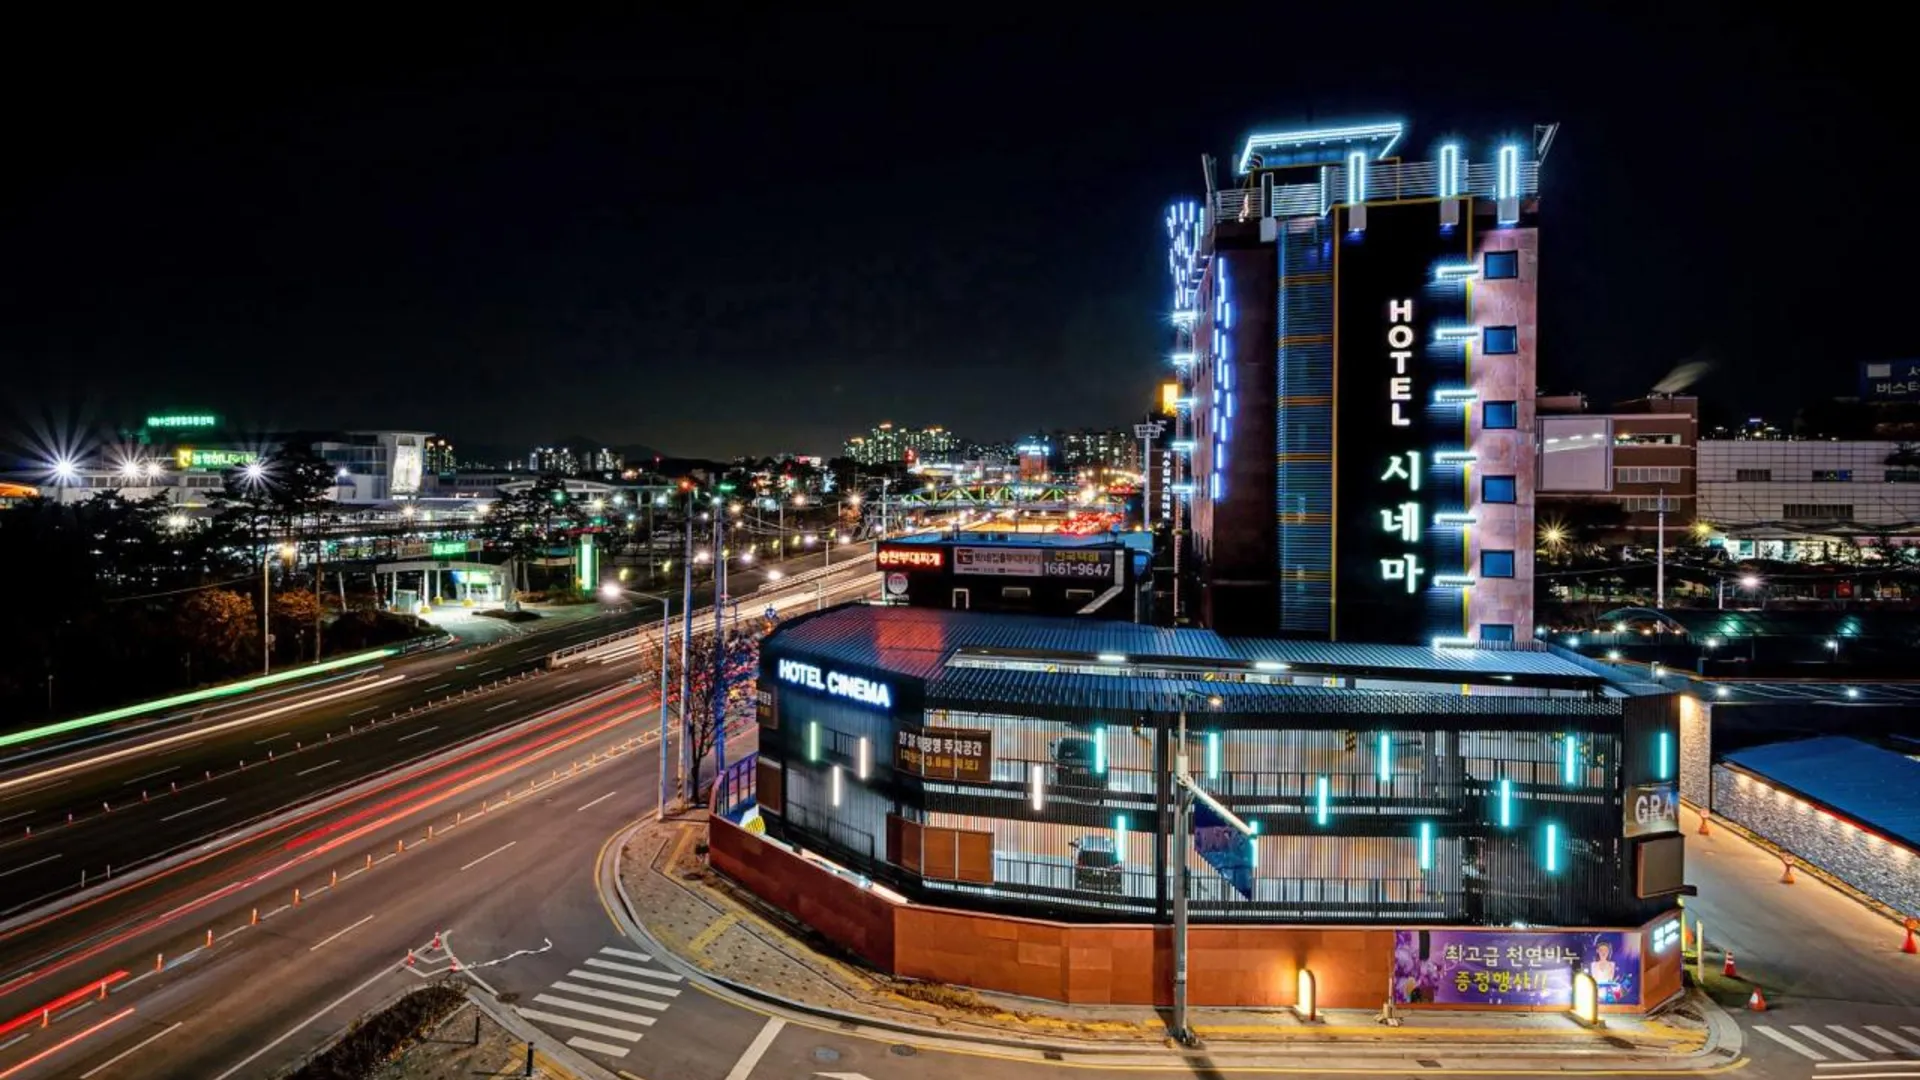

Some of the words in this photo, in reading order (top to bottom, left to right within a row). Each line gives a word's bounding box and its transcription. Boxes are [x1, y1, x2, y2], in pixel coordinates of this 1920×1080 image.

[1388, 299, 1413, 426] HOTEL
[1380, 450, 1424, 594] 시네마
[1044, 562, 1110, 577] 1661-9647
[779, 659, 825, 690] HOTEL
[827, 672, 892, 708] CINEMA
[944, 738, 982, 756] 주차공간
[1445, 944, 1499, 967] 최고급
[1506, 945, 1580, 967] 천연비누
[1455, 971, 1547, 993] 증정행사!!
